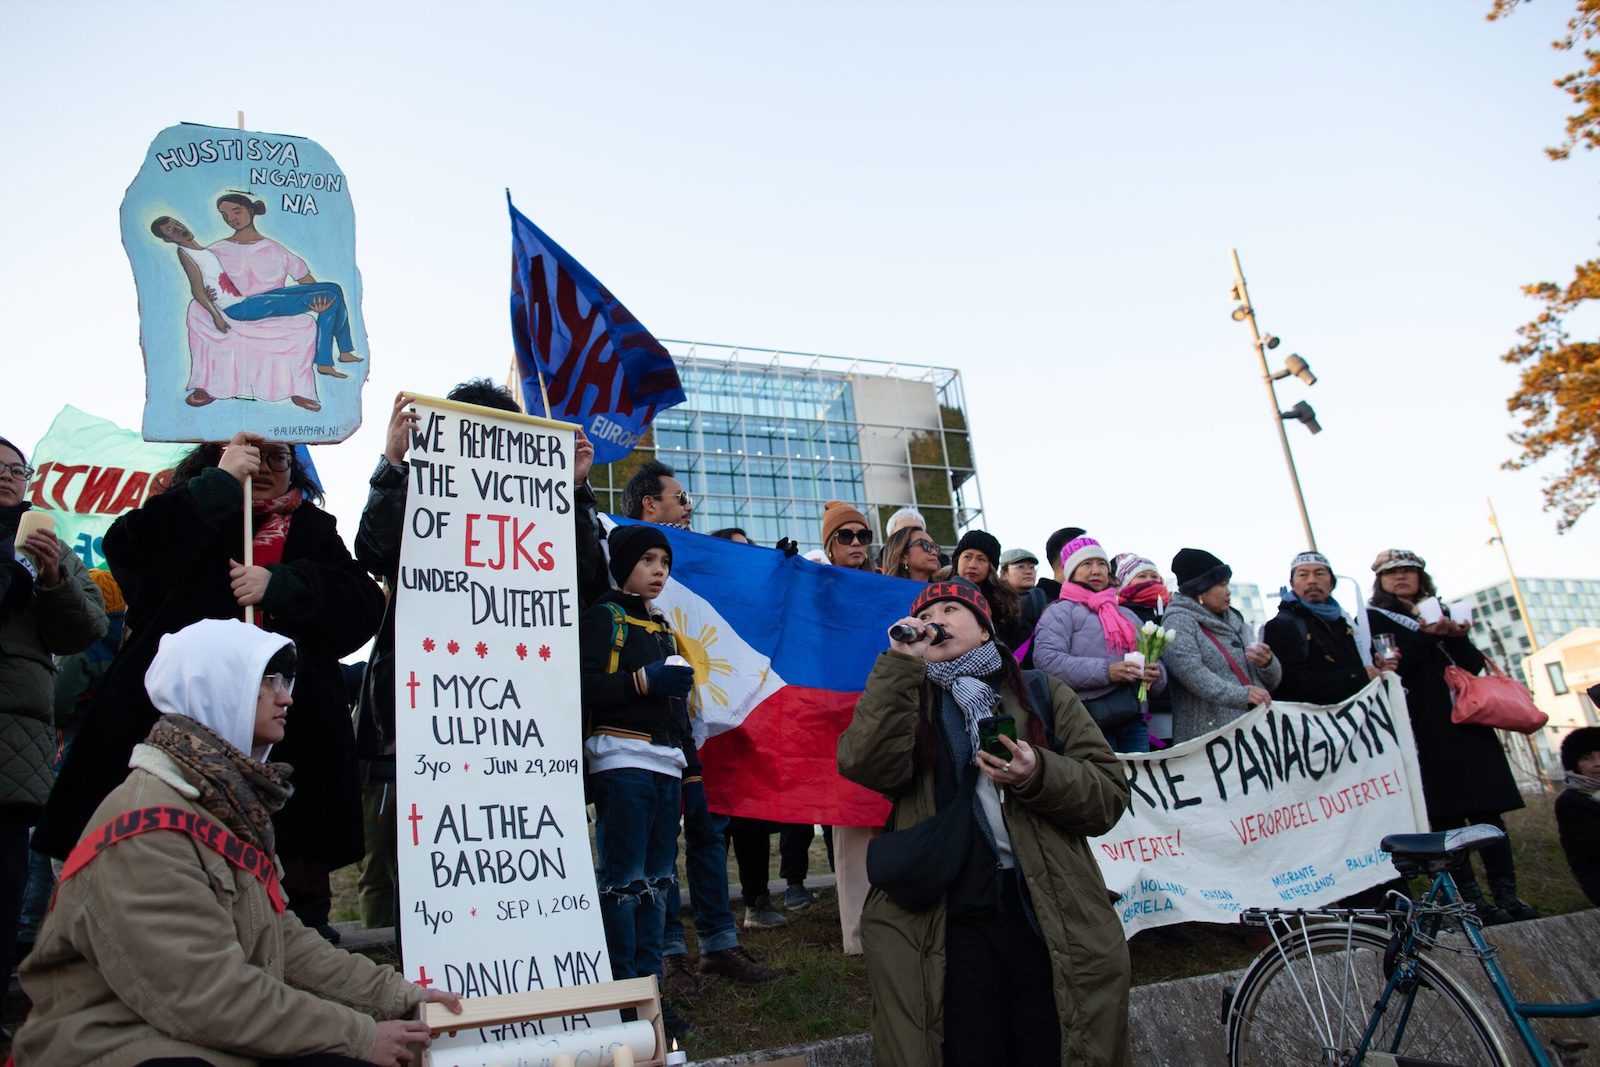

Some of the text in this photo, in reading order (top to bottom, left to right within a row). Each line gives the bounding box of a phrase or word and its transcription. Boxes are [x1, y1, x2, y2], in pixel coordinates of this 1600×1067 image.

[156, 139, 299, 171] HUSTISYA
[251, 169, 342, 192] NGAYON
[282, 194, 319, 215] NA
[410, 408, 566, 469] WE REMEMBER
[410, 459, 571, 514] THE VICTIMS
[412, 507, 555, 572] OF EJKs
[401, 566, 573, 627] UNDER DUTERTE
[432, 674, 521, 710] MYCA
[432, 715, 545, 748] ULPINA
[1206, 680, 1399, 801] PANAGUTIN
[483, 756, 518, 775] JUN
[433, 804, 564, 845] ALTHEA
[1230, 770, 1403, 845] VERORDEEL DUTERTE!
[95, 807, 274, 882] JUSTICE NOW
[1101, 828, 1184, 862] DUTERTE!
[430, 847, 567, 888] BARBON
[1272, 865, 1317, 887] MIGRANTE
[1279, 873, 1336, 901] NETHERLANDS
[496, 900, 529, 921] SEP
[444, 950, 601, 999] DANICA MAY
